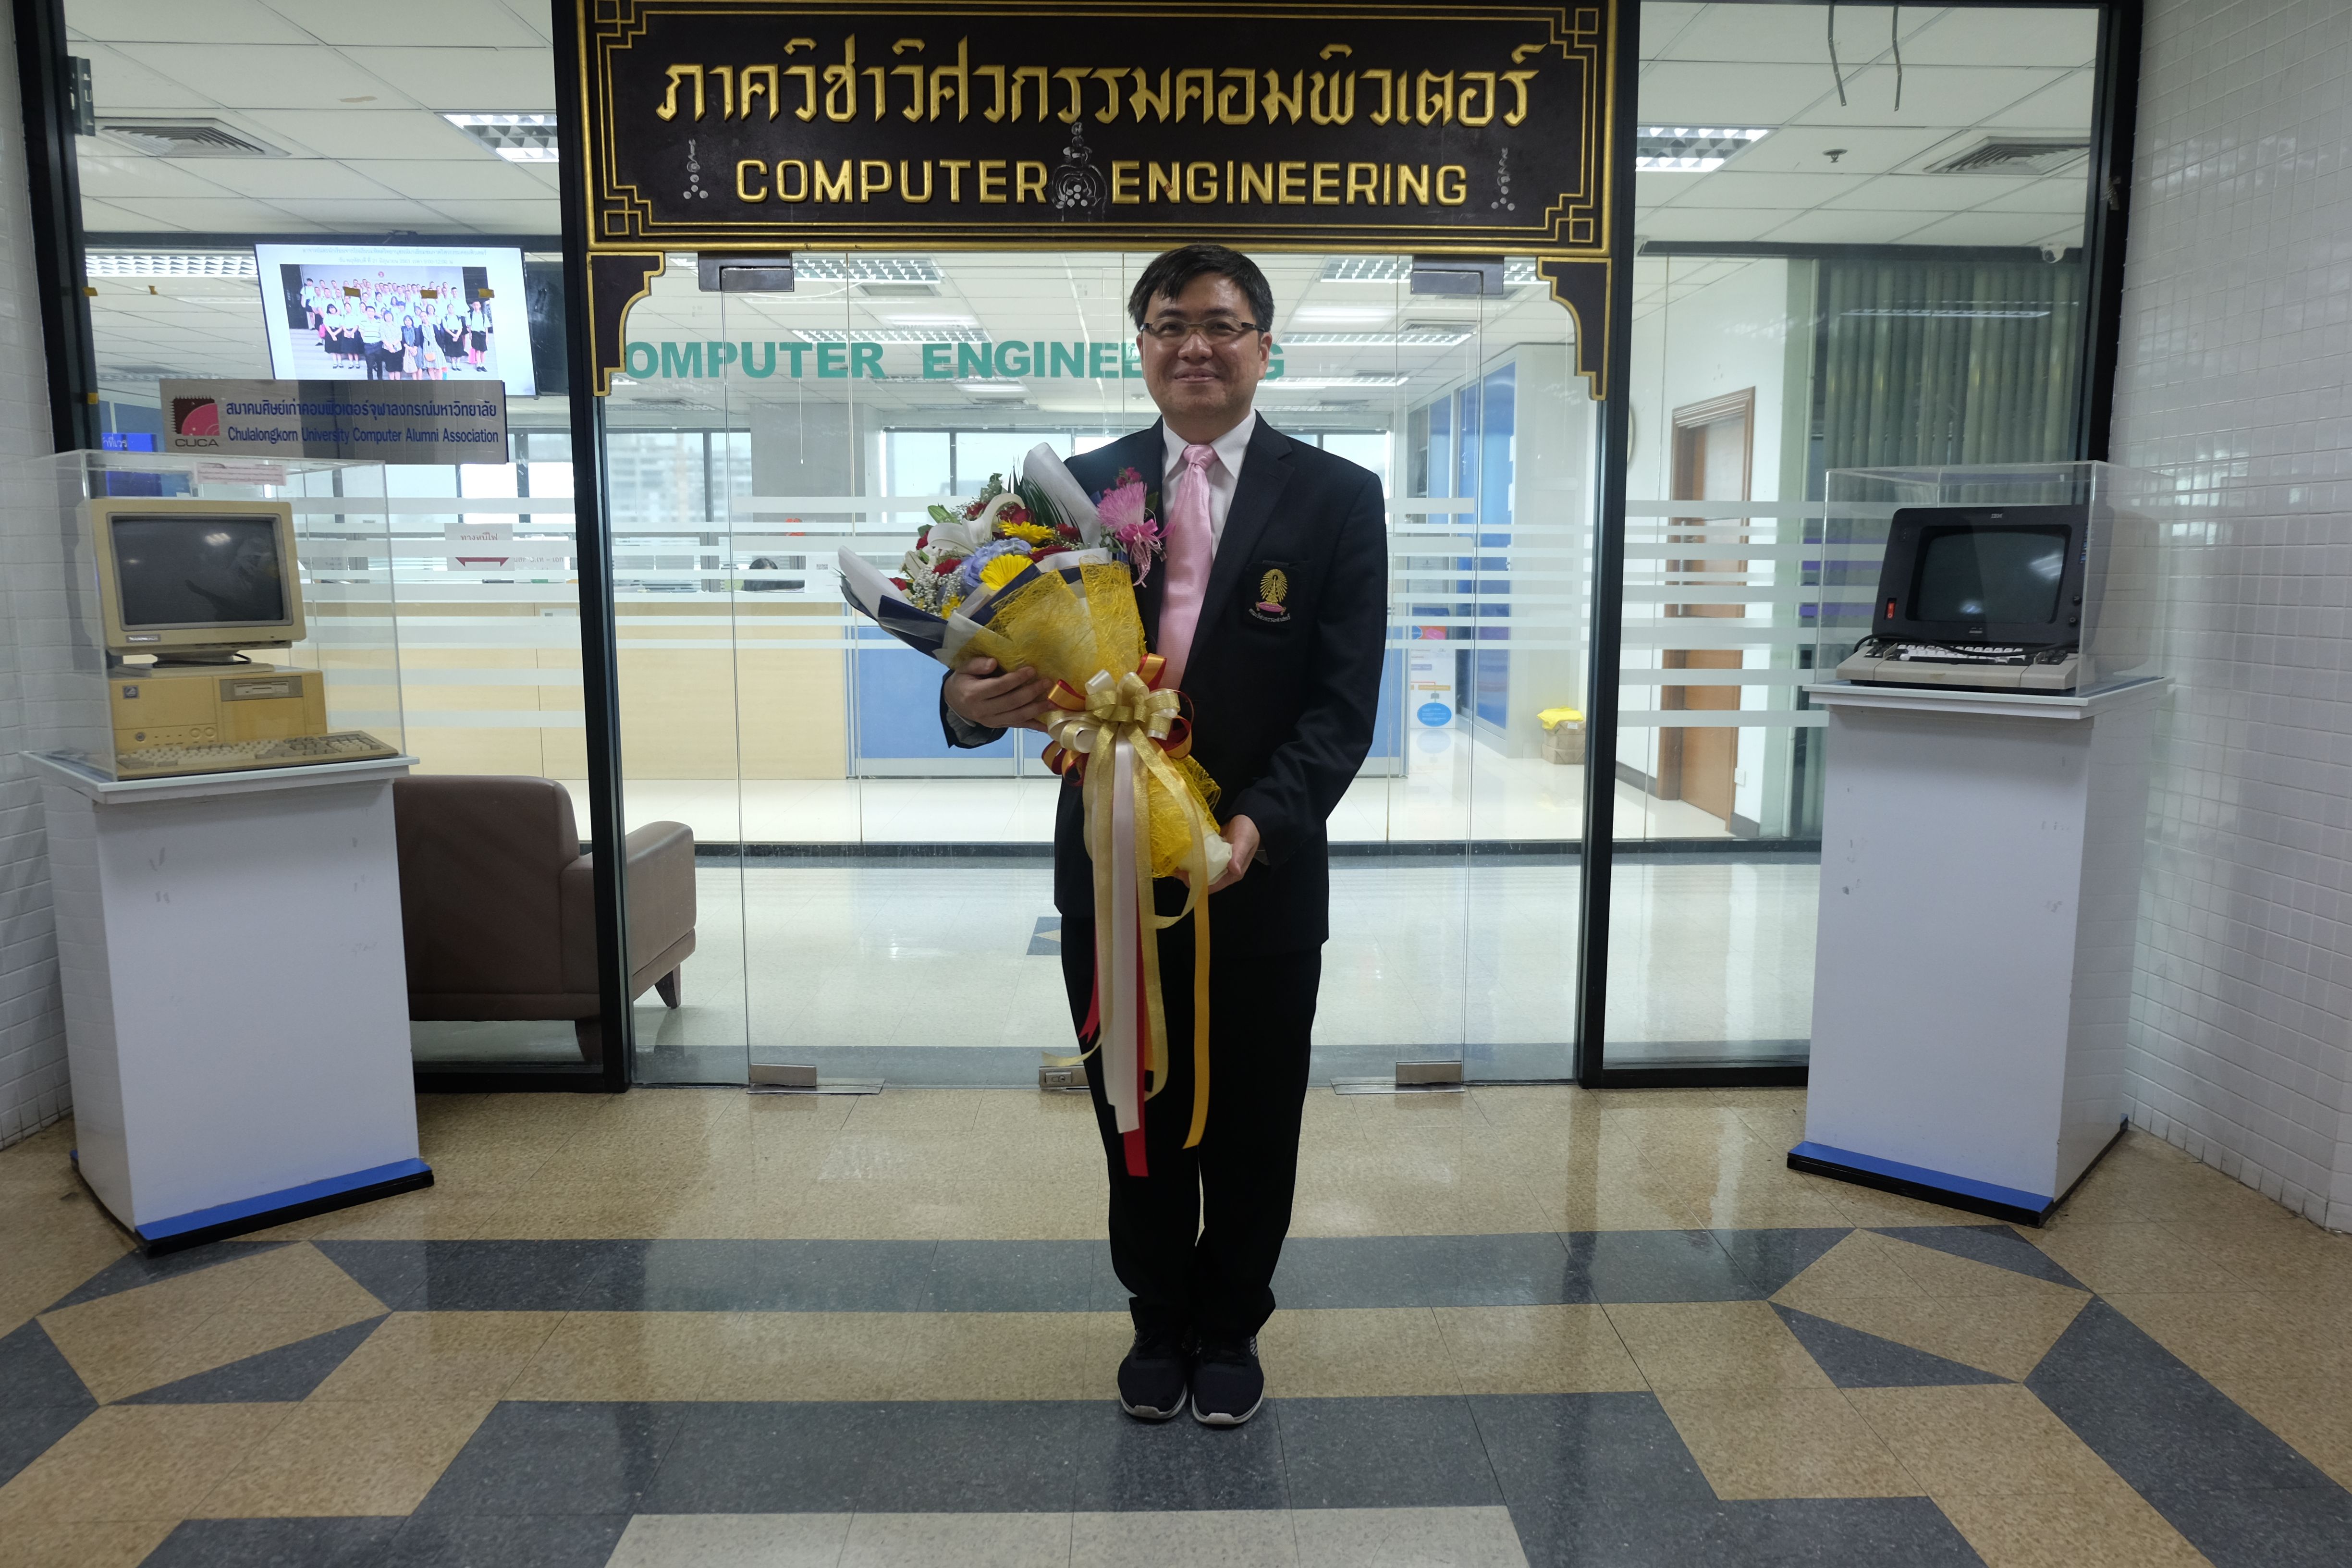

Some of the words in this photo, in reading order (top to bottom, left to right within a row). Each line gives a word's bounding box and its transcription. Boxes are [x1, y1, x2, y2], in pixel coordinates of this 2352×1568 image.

[655, 33, 1547, 127] ภาควิชาวิศวกรรมคอมพิวเตอร์
[735, 159, 1047, 204] COMPUTER
[1111, 160, 1467, 206] ENGINEERING
[625, 341, 886, 379] OMPUTER
[226, 398, 497, 420] สมาคมศิษย์เก่าคอมพิวเตอร์จุฬาลงกรณ์มหาวิทยาลัย
[175, 439, 219, 447] CUCA
[228, 426, 298, 444] Chulalongkorn
[301, 427, 349, 444] University
[353, 427, 402, 444] Computer
[405, 428, 439, 442] Alumni
[442, 428, 499, 442] Association
